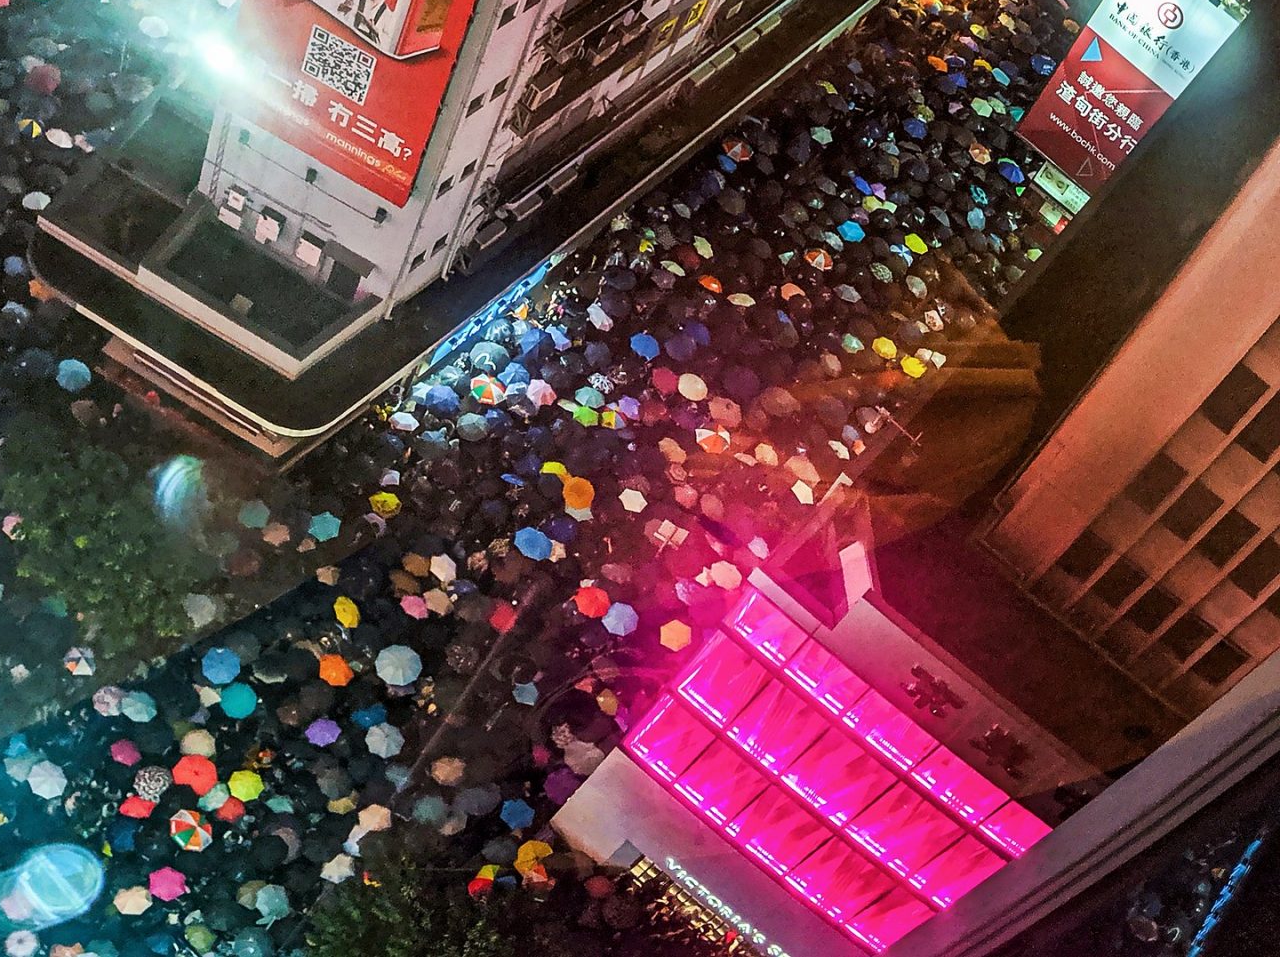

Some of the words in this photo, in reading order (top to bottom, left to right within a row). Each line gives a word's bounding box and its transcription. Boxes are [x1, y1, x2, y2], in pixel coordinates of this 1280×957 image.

[1109, 13, 1127, 32] BANK
[1138, 38, 1160, 59] CHINA
[1055, 80, 1138, 155] 渣甸街分行
[1077, 71, 1144, 131] 誠邀您親臨
[325, 132, 381, 167] mannings
[1049, 112, 1116, 171] www.bochk.com
[665, 856, 766, 944] VICTORIA'S
